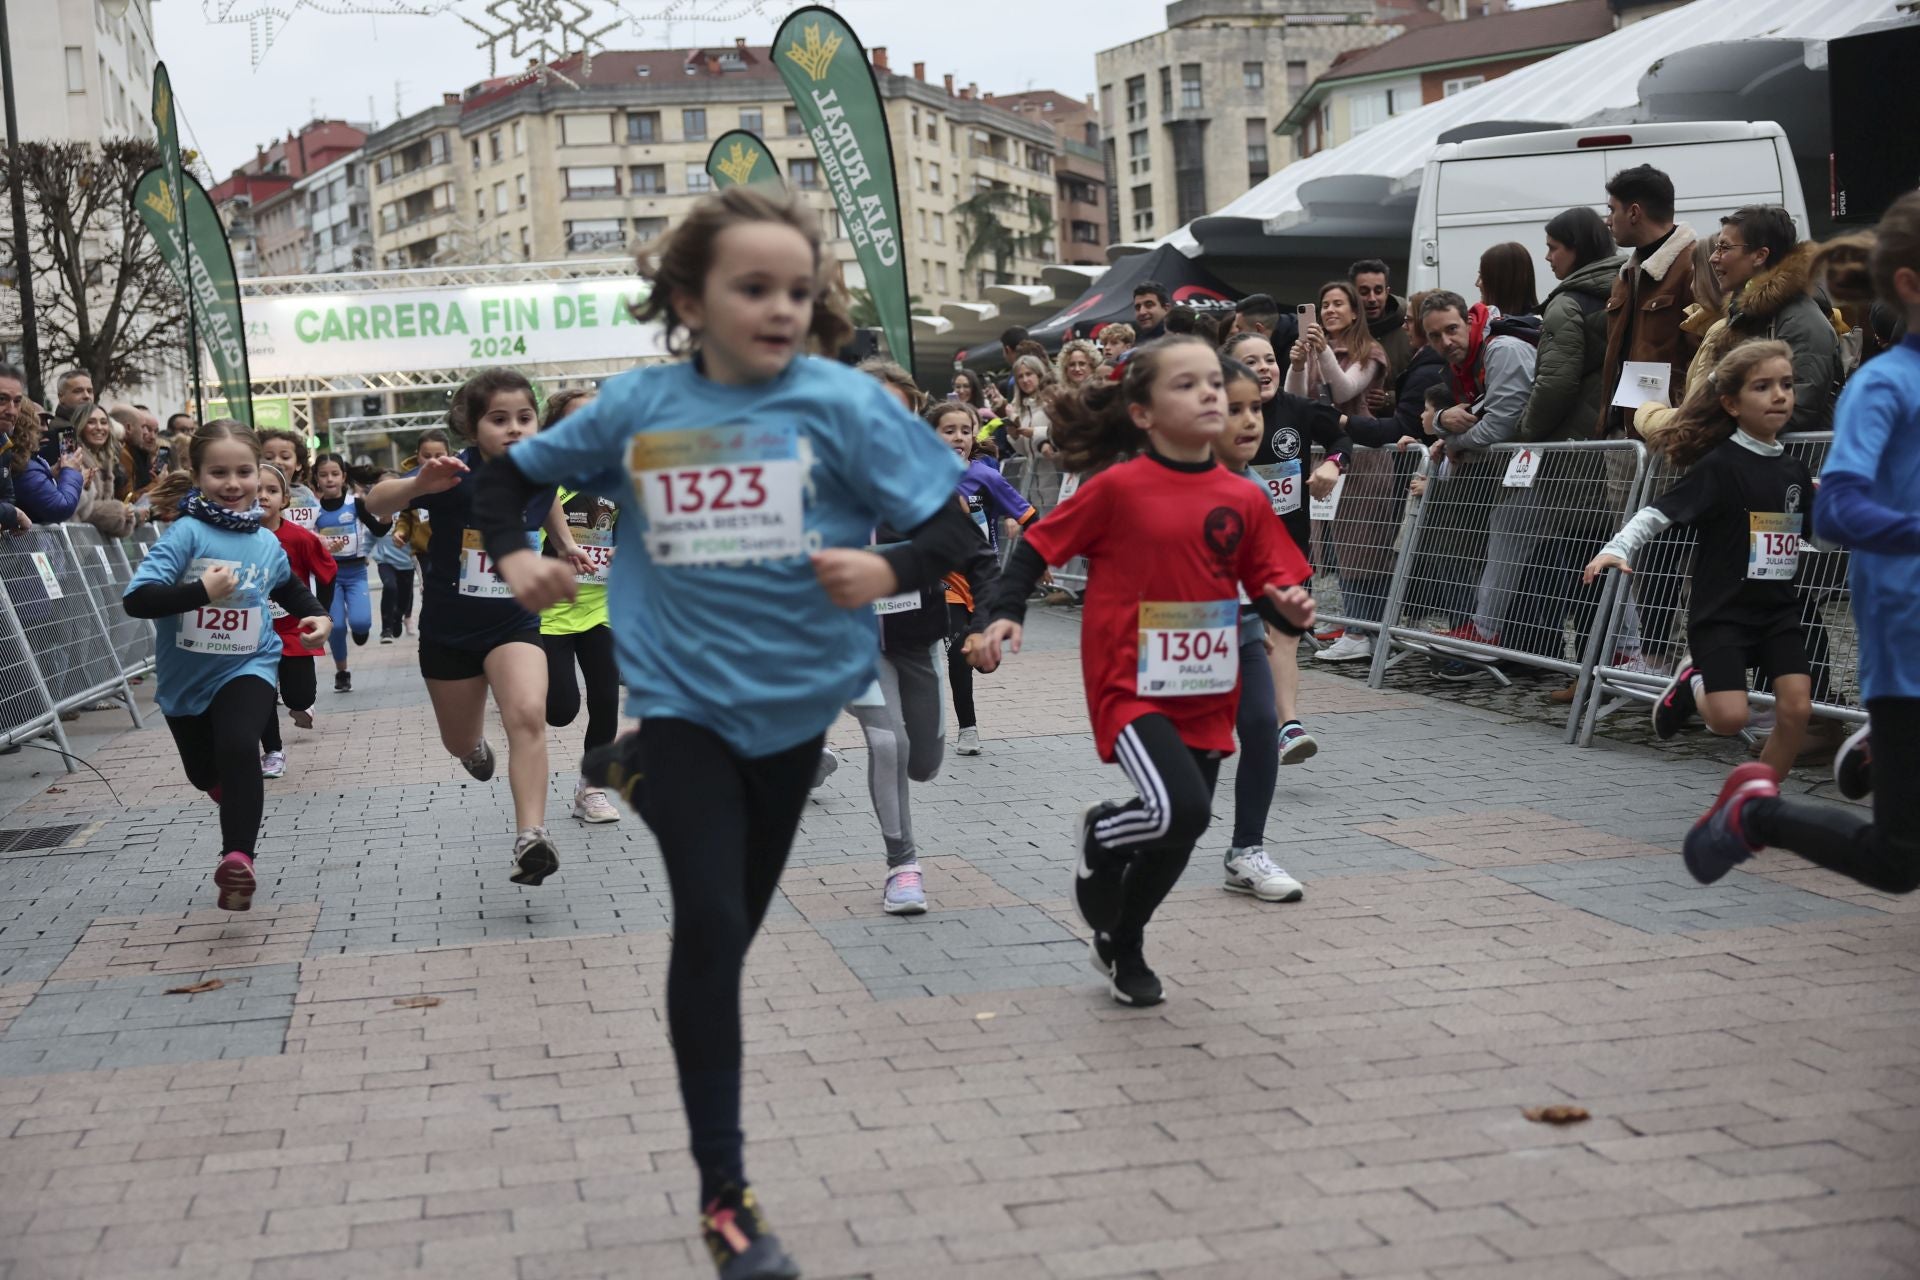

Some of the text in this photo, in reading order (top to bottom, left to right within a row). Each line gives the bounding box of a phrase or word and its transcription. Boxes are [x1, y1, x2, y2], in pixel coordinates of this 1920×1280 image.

[294, 302, 470, 344] CARRERA
[481, 297, 540, 334] FIN
[553, 293, 599, 330] DE
[469, 335, 527, 359] 2024
[657, 466, 768, 514] 1323
[290, 508, 313, 521] 1291
[196, 607, 249, 632] 1281
[206, 642, 254, 652] PDMSiero
[210, 633, 231, 641] ANA
[1157, 630, 1229, 662] 1304
[1178, 664, 1213, 674] PAULA
